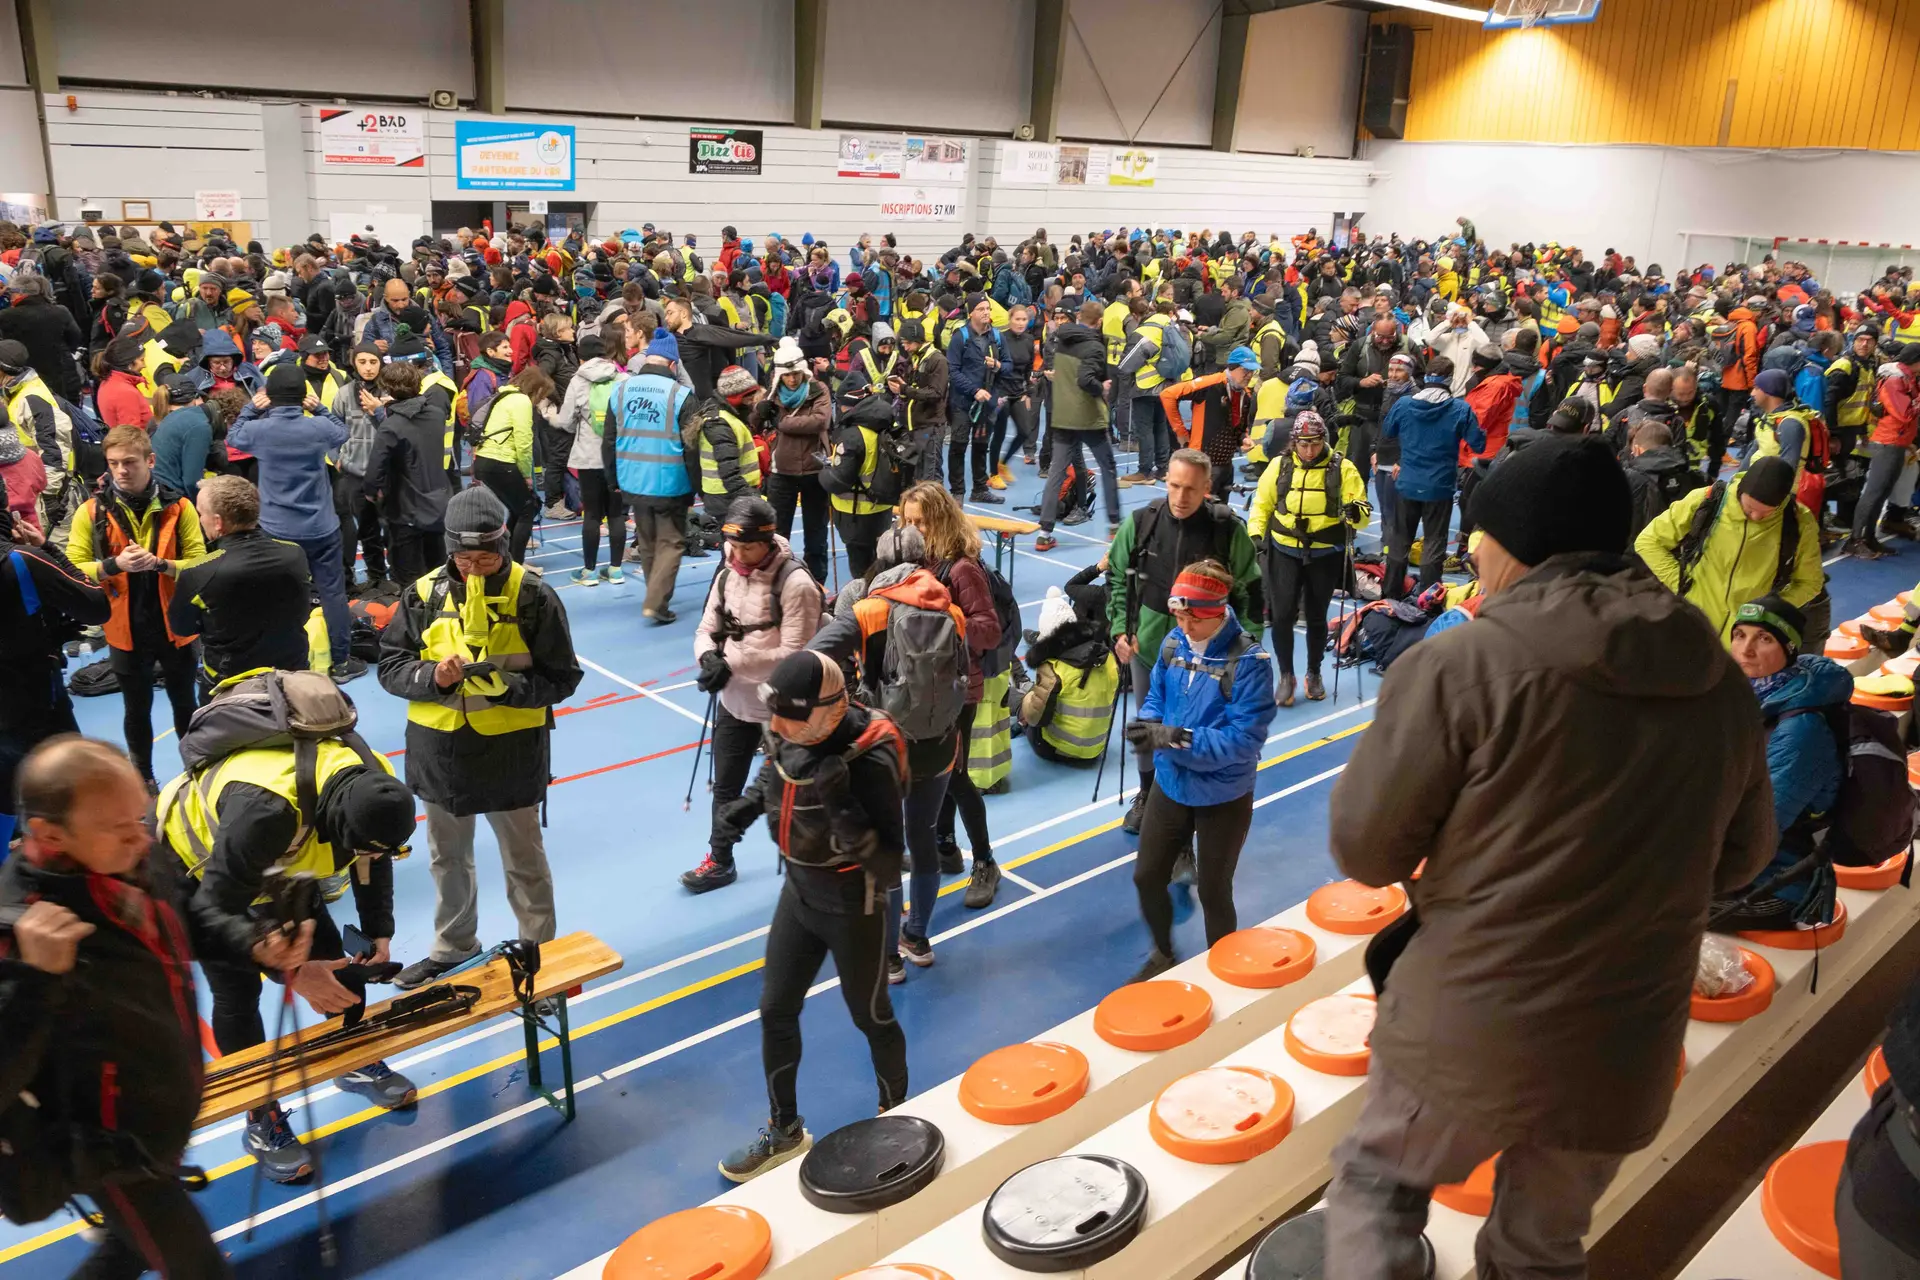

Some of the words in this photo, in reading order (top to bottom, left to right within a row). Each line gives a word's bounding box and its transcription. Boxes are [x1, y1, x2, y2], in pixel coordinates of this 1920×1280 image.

[479, 150, 519, 161] DEVENEZ
[1028, 151, 1054, 159] ROBIN
[471, 165, 527, 175] PARTENAIRE
[530, 167, 541, 175] DU
[881, 203, 932, 215] INSCRIPTIONS
[934, 204, 943, 215] 57
[944, 204, 956, 215] KM
